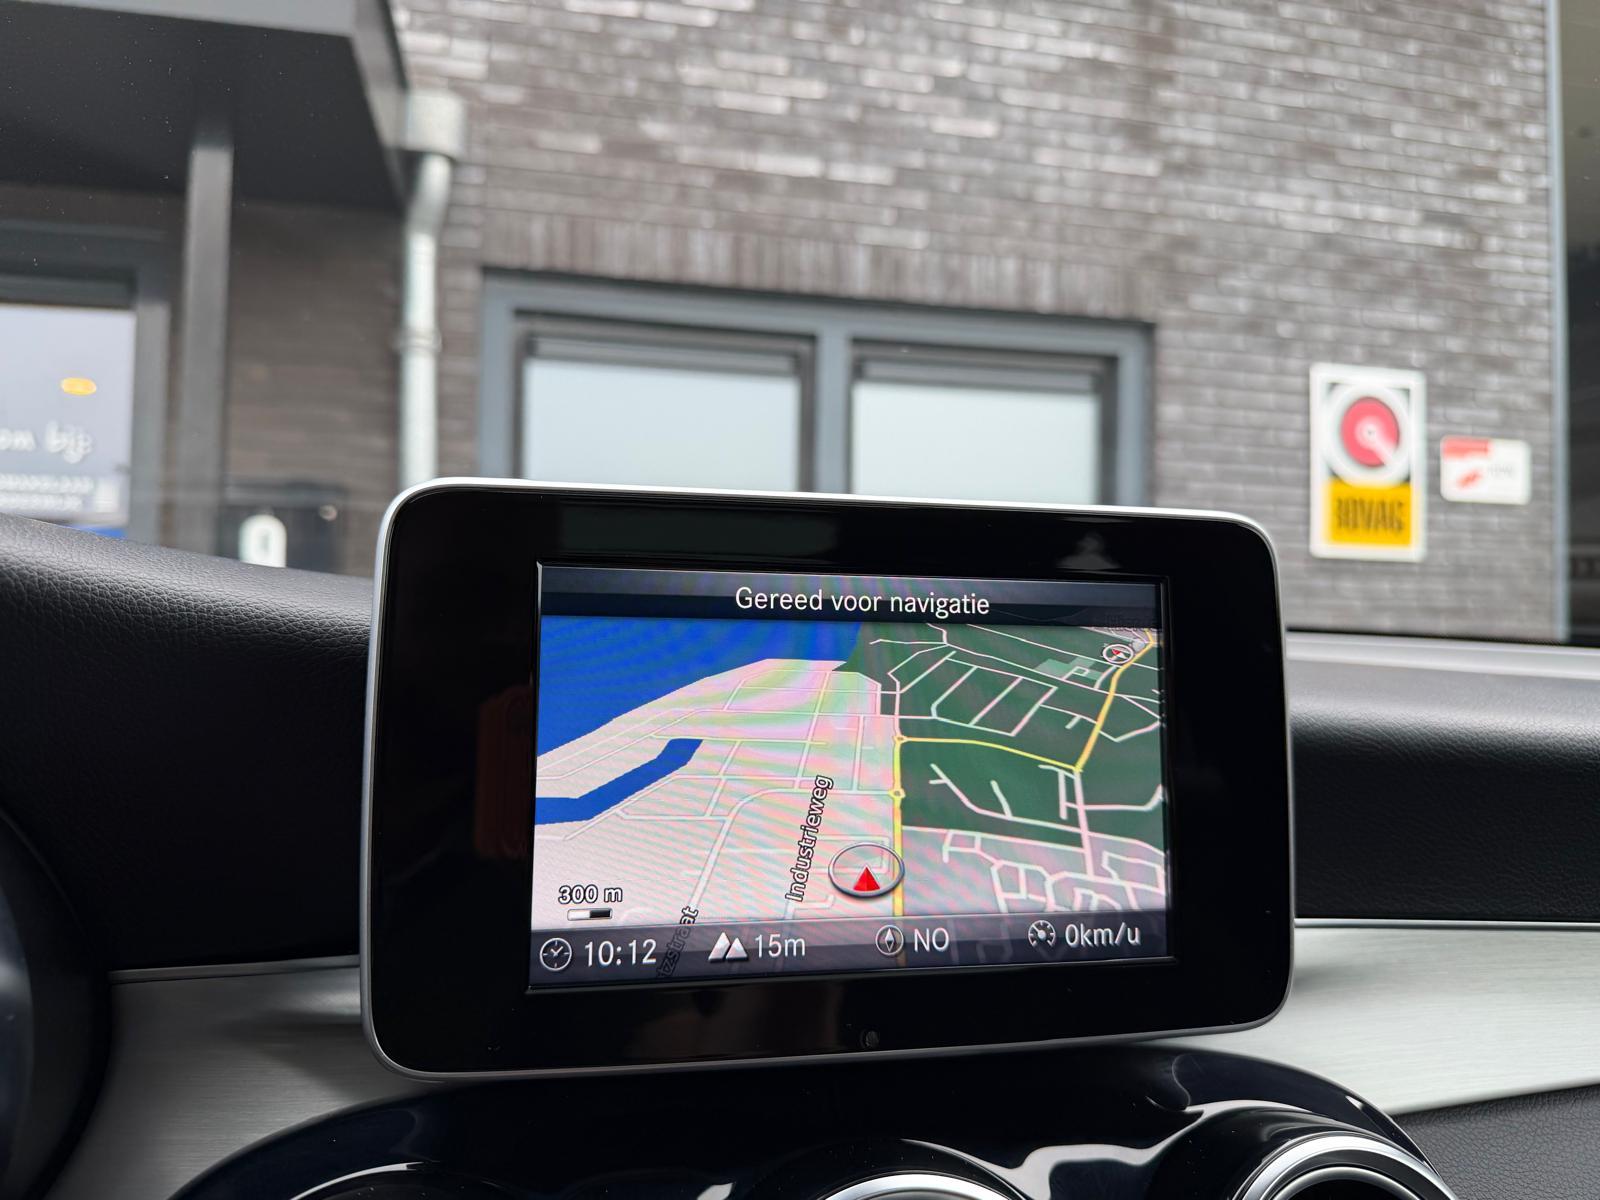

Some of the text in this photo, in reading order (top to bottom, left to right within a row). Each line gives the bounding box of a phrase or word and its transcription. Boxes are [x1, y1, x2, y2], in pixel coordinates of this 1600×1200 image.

[735, 586, 990, 620] Gereed voor navigatie
[785, 775, 834, 902] Industrieweg
[558, 884, 623, 904] 300 m
[754, 933, 806, 959] 15m
[914, 927, 950, 952] NO
[1064, 922, 1142, 948] 0km/u
[584, 938, 658, 967] 10:12
